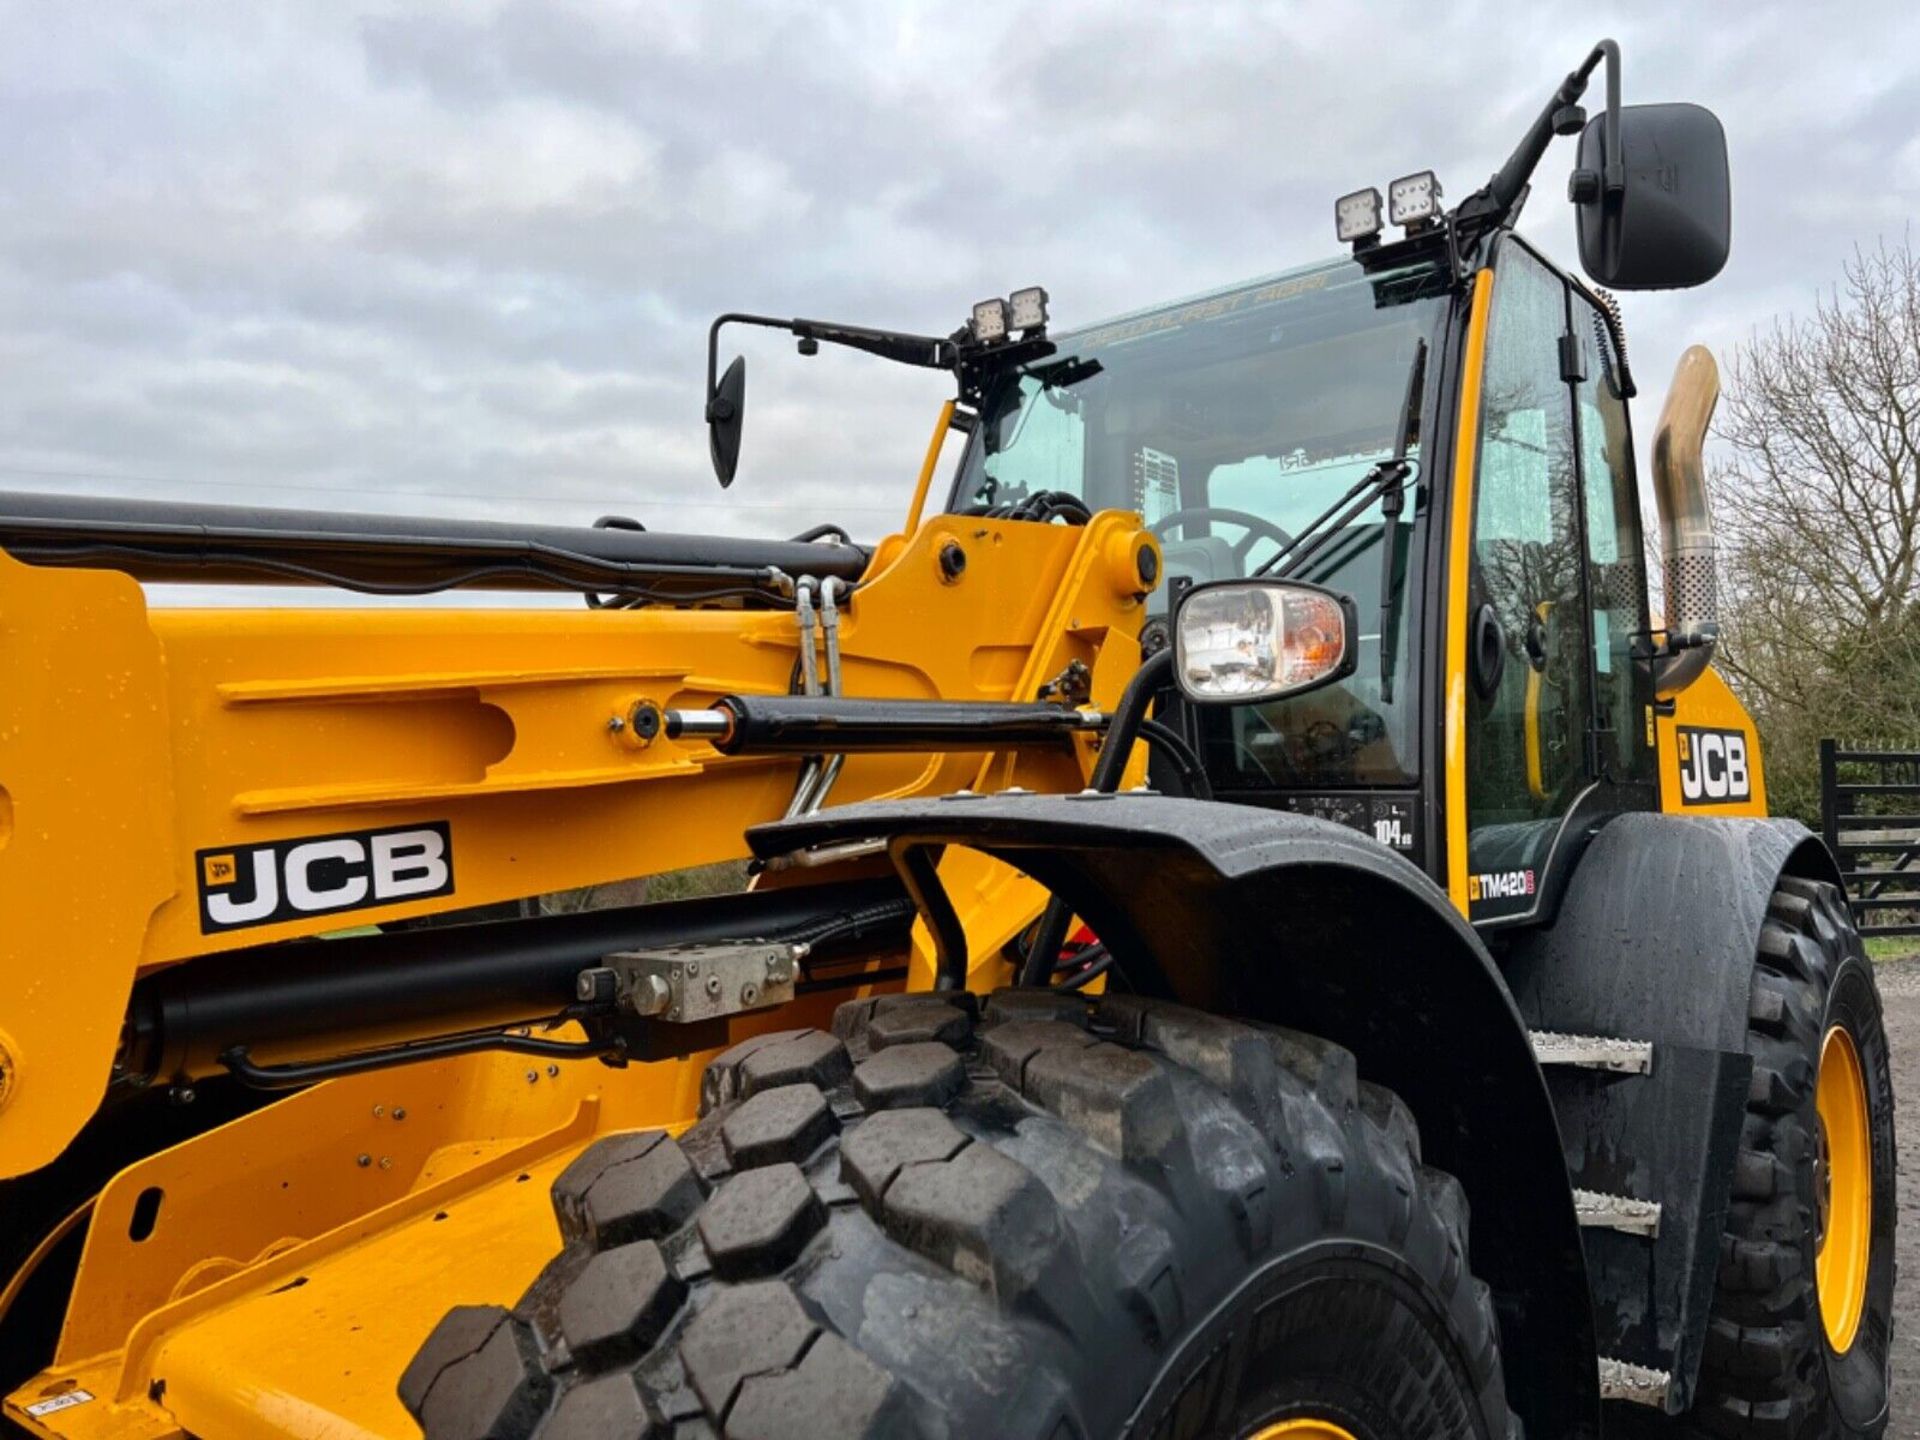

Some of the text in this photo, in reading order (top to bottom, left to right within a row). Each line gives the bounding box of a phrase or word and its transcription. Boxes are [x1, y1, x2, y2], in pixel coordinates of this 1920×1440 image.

[1681, 733, 1749, 799] JCB
[1374, 820, 1400, 844] 104
[206, 829, 448, 924] JCB
